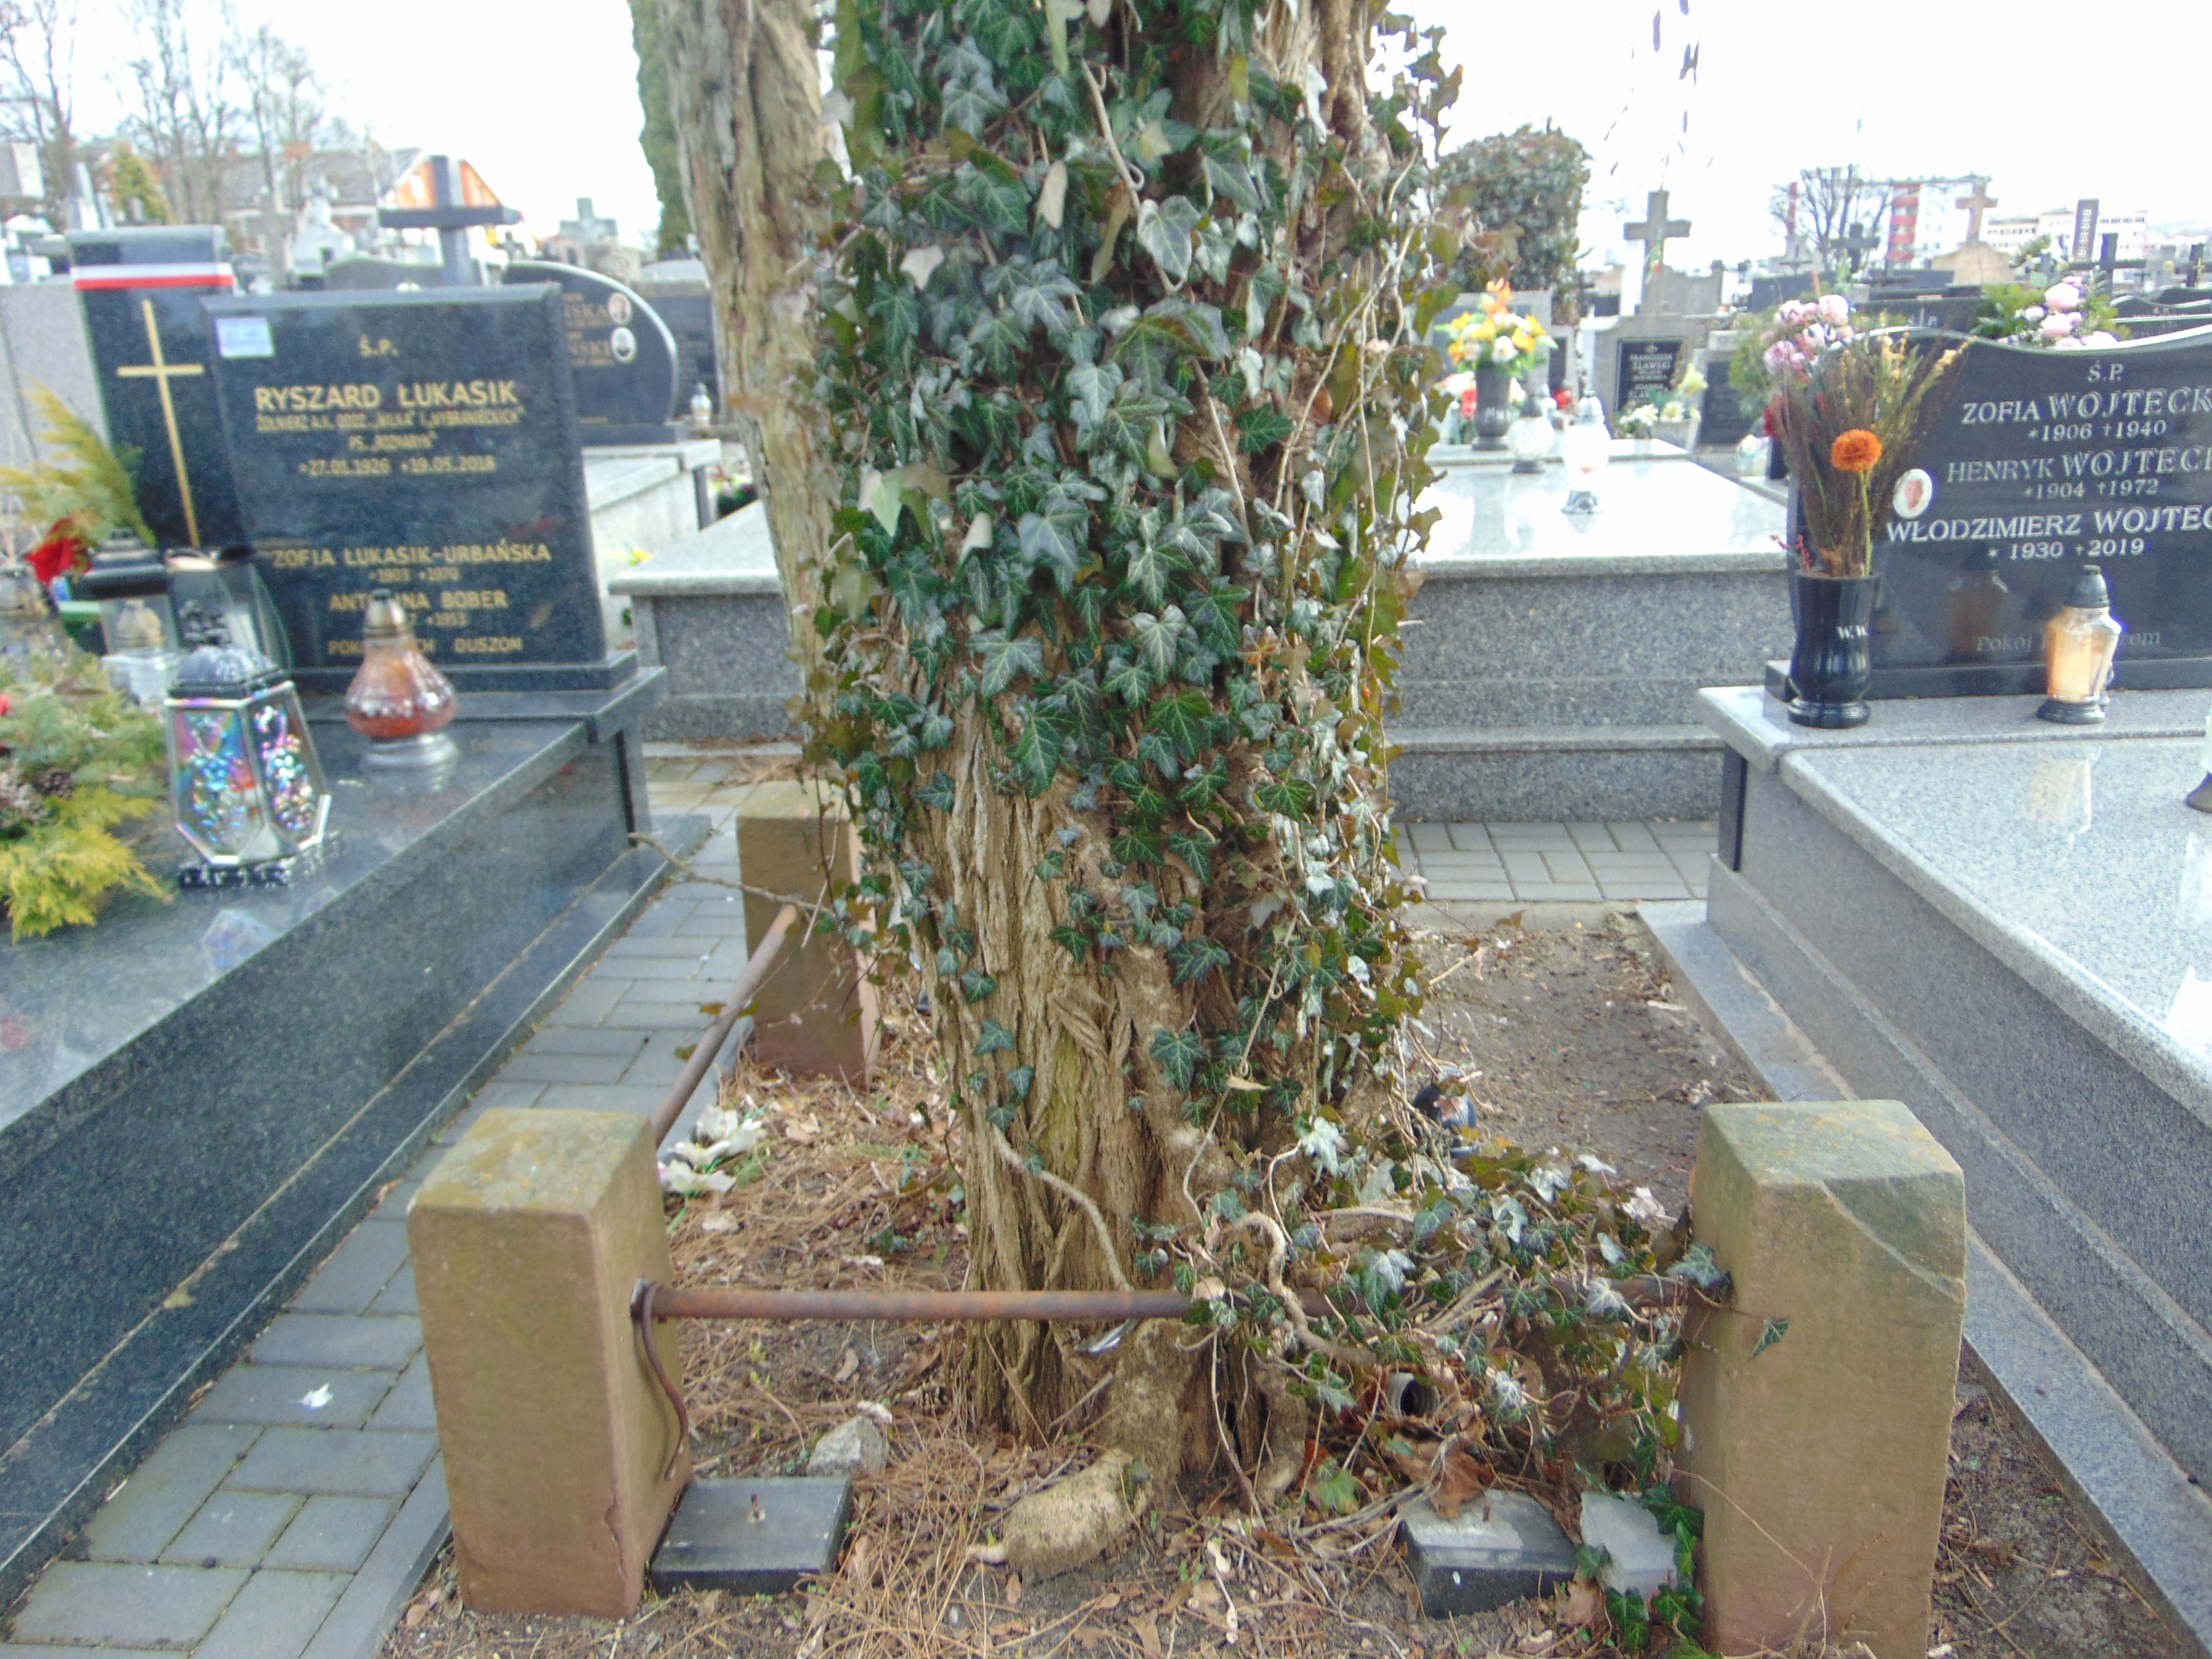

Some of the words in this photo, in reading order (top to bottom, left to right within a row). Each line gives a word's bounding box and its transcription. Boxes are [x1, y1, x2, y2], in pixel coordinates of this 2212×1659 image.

[254, 384, 382, 411] RYSZARD
[397, 380, 518, 408] ŁUKASIK
[1963, 399, 2040, 424] ZOFIA
[1947, 458, 2054, 483] HENRYK
[1886, 514, 2082, 542] WŁODZIMIERZ
[272, 549, 337, 568] ZOFIA
[343, 538, 552, 566] ŁUKASIK-URBAŃSKA
[329, 591, 431, 611] ANTINA
[441, 589, 509, 610] BOBER
[453, 637, 524, 655] DUSZOM
